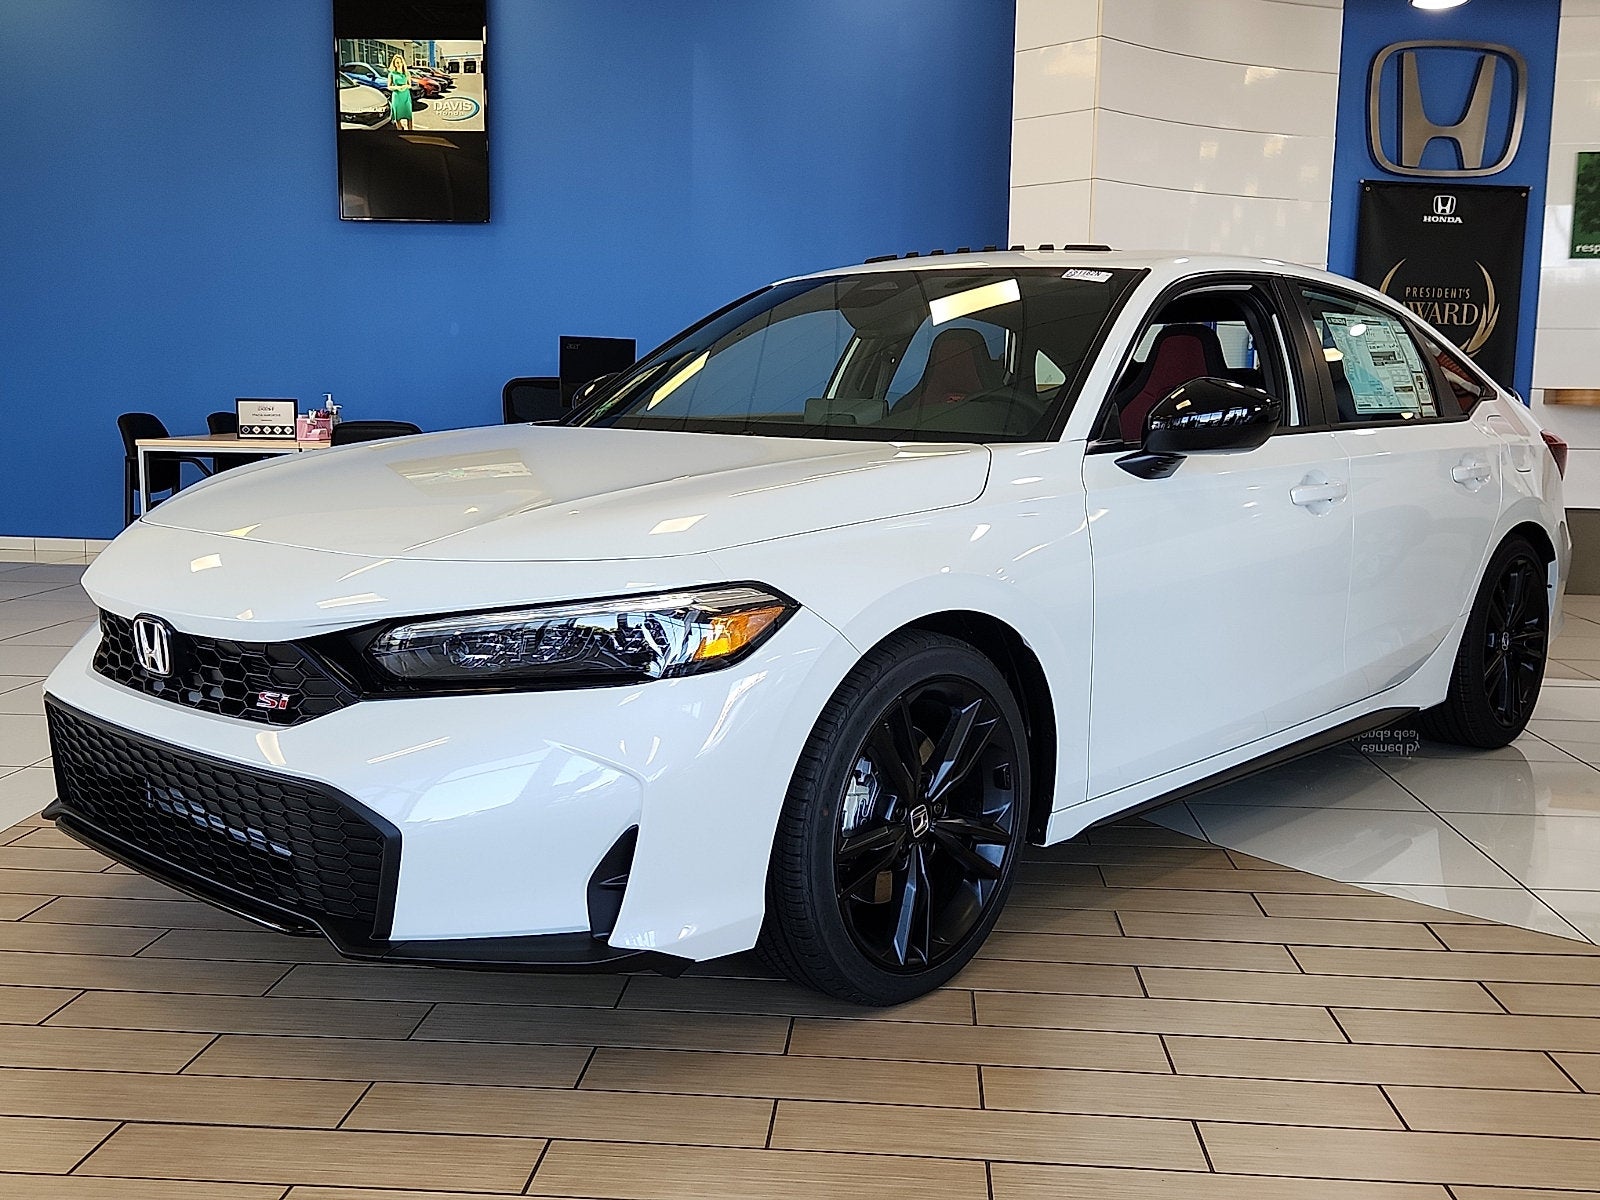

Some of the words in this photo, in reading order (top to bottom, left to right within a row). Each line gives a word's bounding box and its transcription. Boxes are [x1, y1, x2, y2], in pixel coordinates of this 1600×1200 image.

[433, 101, 472, 111] DAVIS
[1423, 215, 1463, 224] HONDA
[1405, 286, 1470, 299] PRESIDENT'S
[1403, 301, 1479, 326] WARD
[256, 691, 290, 710] Si
